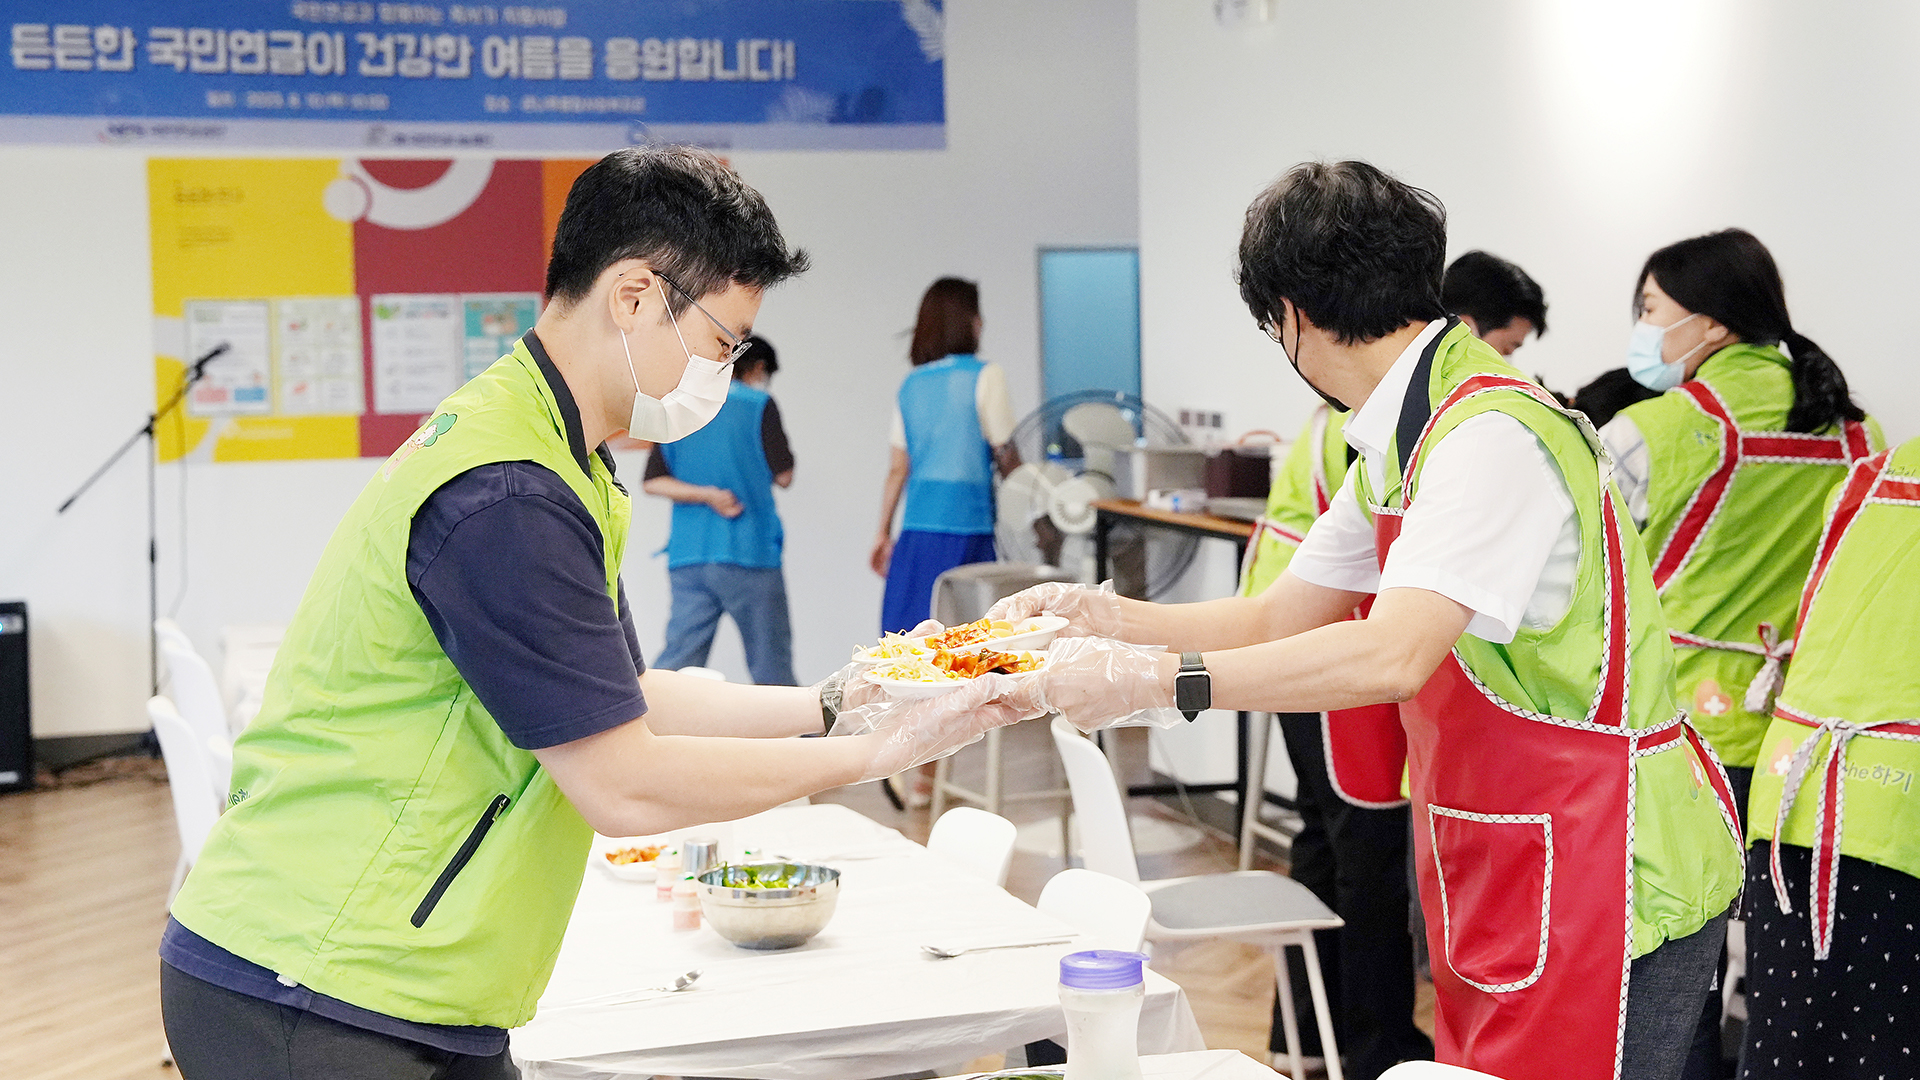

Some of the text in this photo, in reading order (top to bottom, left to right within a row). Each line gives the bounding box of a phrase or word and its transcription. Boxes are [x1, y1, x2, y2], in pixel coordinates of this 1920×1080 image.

[11, 23, 796, 81] 든든한 국민연금이 건강한 여름을 응원합니다!
